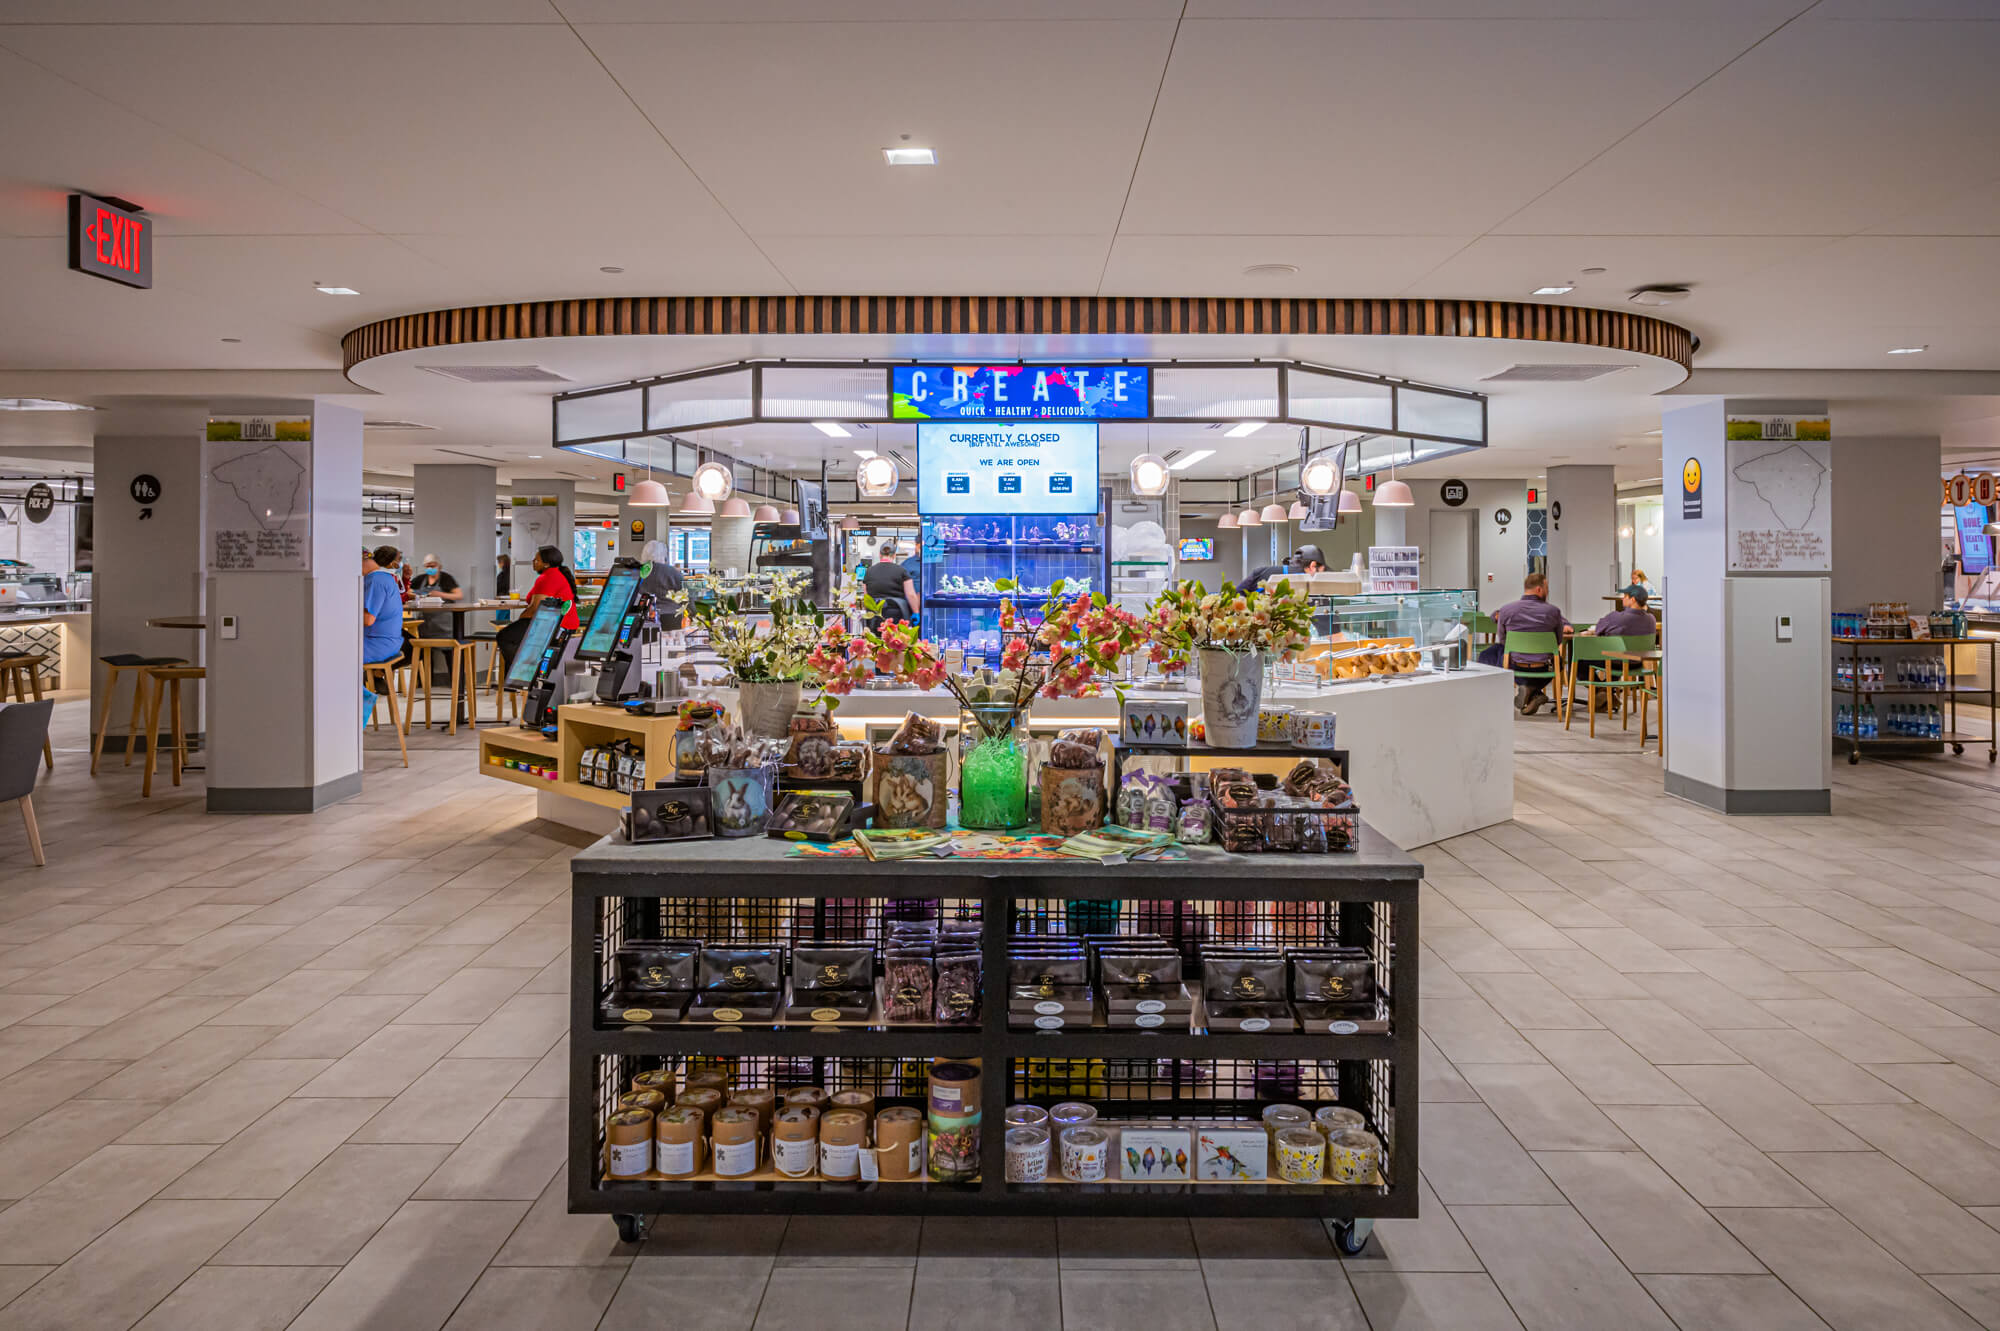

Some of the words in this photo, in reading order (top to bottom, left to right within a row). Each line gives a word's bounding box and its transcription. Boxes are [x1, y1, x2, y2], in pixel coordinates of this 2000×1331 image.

[97, 207, 143, 273] EXIT
[912, 371, 1129, 402] CREATE
[960, 406, 986, 416] QUICK
[995, 406, 1032, 416] HEALTHY
[1041, 406, 1085, 416] DELICIOUS
[244, 423, 272, 438] LOCAL
[1765, 423, 1793, 437] LOCAL
[949, 433, 1013, 443] CURRENTLY
[1017, 433, 1060, 443] CLOSED
[979, 458, 993, 466] WE
[996, 458, 1014, 466] ARE
[1017, 458, 1040, 466] OPEN
